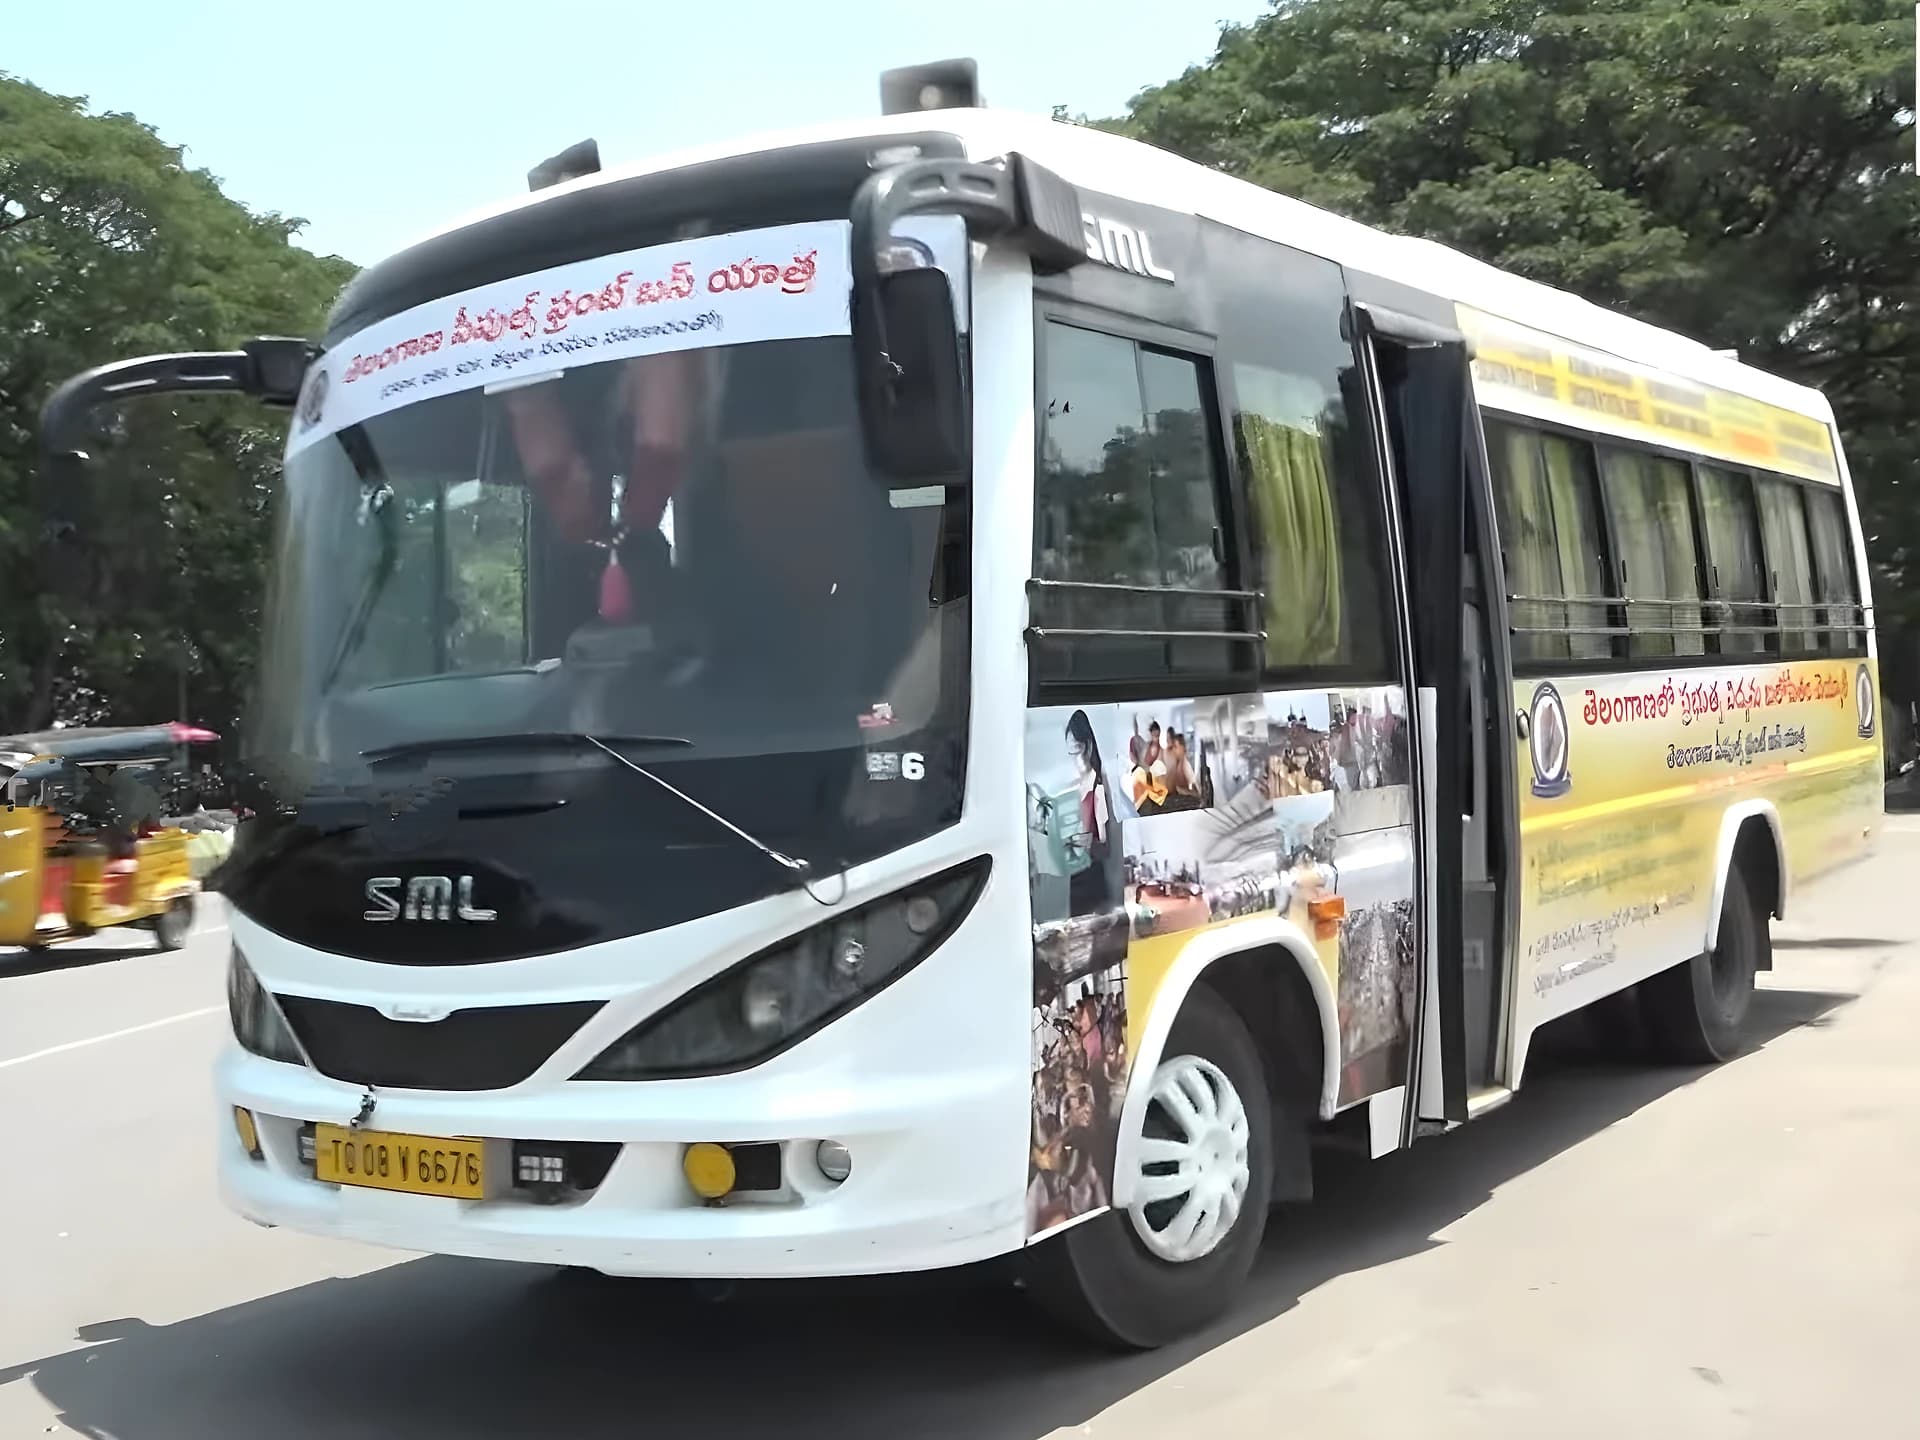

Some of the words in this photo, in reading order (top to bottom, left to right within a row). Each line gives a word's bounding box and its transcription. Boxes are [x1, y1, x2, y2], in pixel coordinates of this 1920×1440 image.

[1081, 212, 1175, 284] SML
[708, 250, 818, 294] యాత్ర
[1583, 677, 1675, 726] తెలంగాణలో
[901, 752, 925, 780] 6
[364, 875, 498, 921] SML
[418, 1149, 481, 1185] 6676
